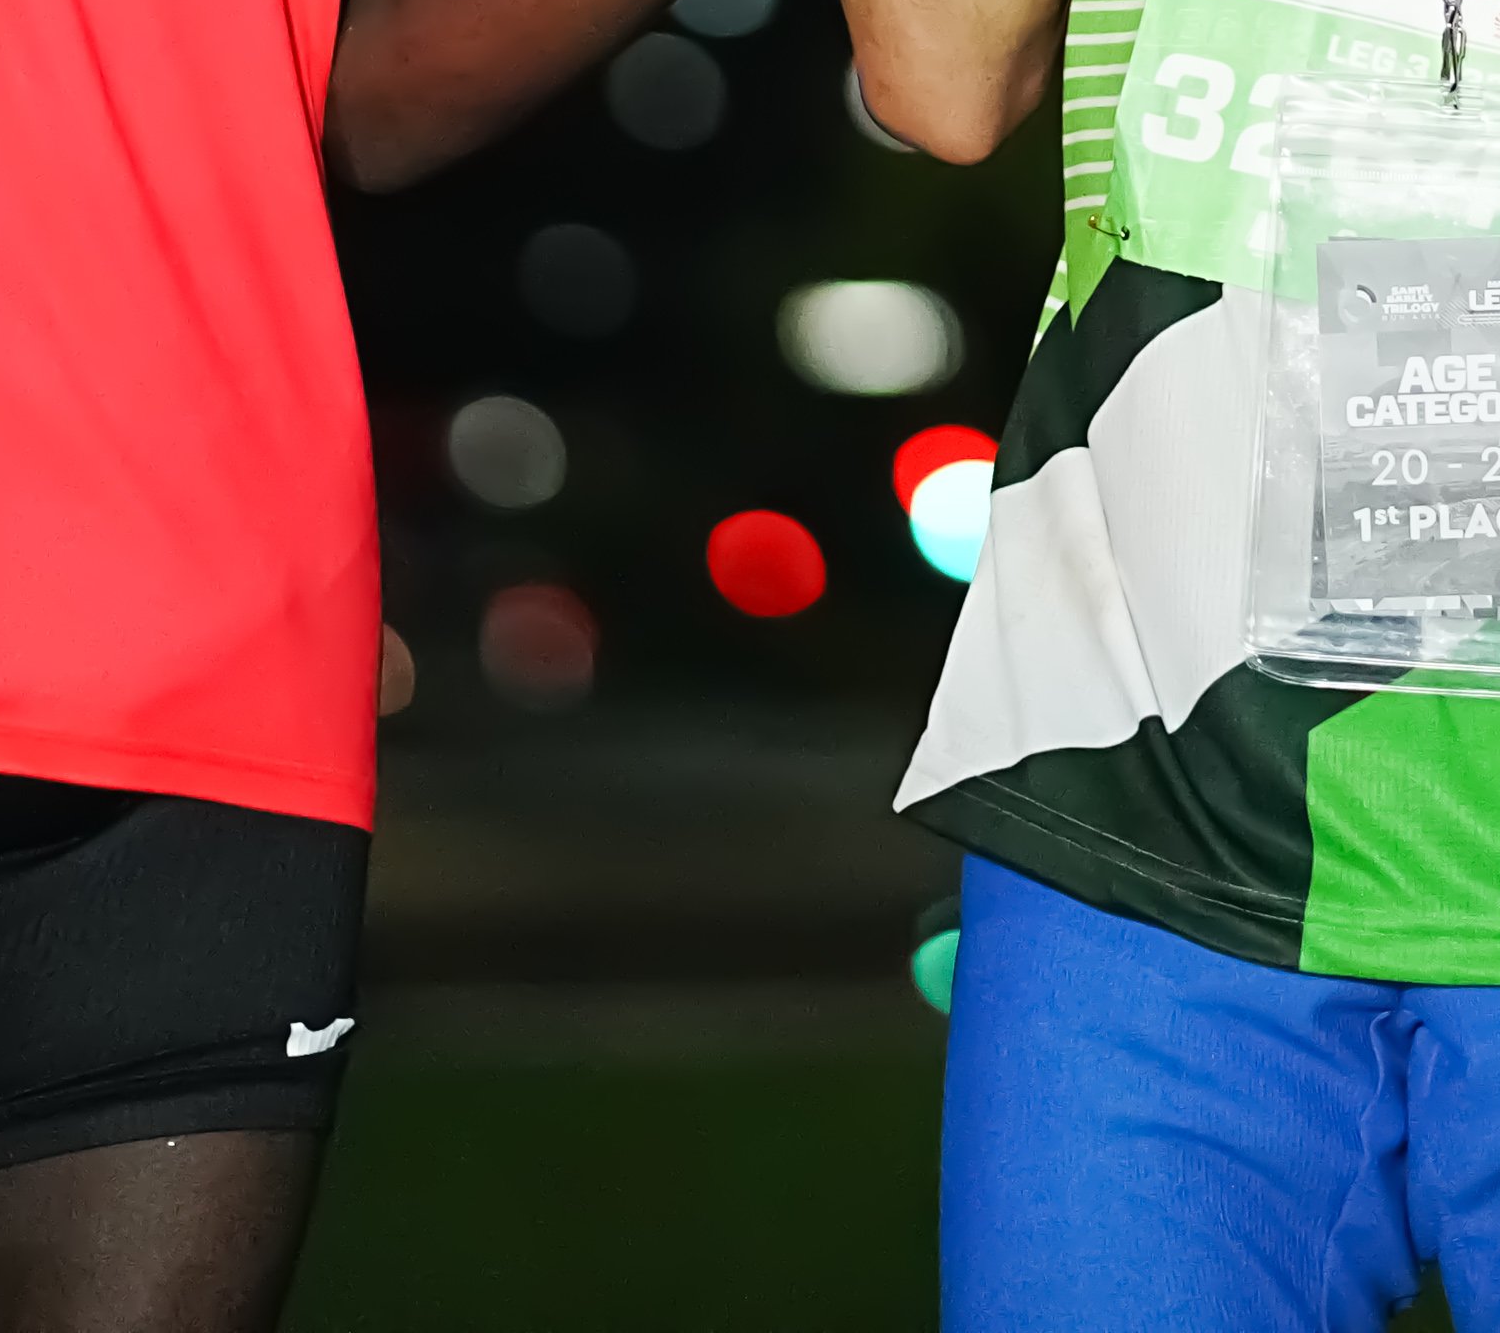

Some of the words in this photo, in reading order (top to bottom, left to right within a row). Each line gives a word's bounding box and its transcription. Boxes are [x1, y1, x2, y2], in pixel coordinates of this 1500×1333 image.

[1326, 34, 1393, 74] LEG
[1404, 53, 1431, 80] 3
[1382, 302, 1440, 314] TRILOGY
[1398, 353, 1497, 393] AGE
[1371, 449, 1428, 486] 20
[1353, 505, 1400, 542] 1st
